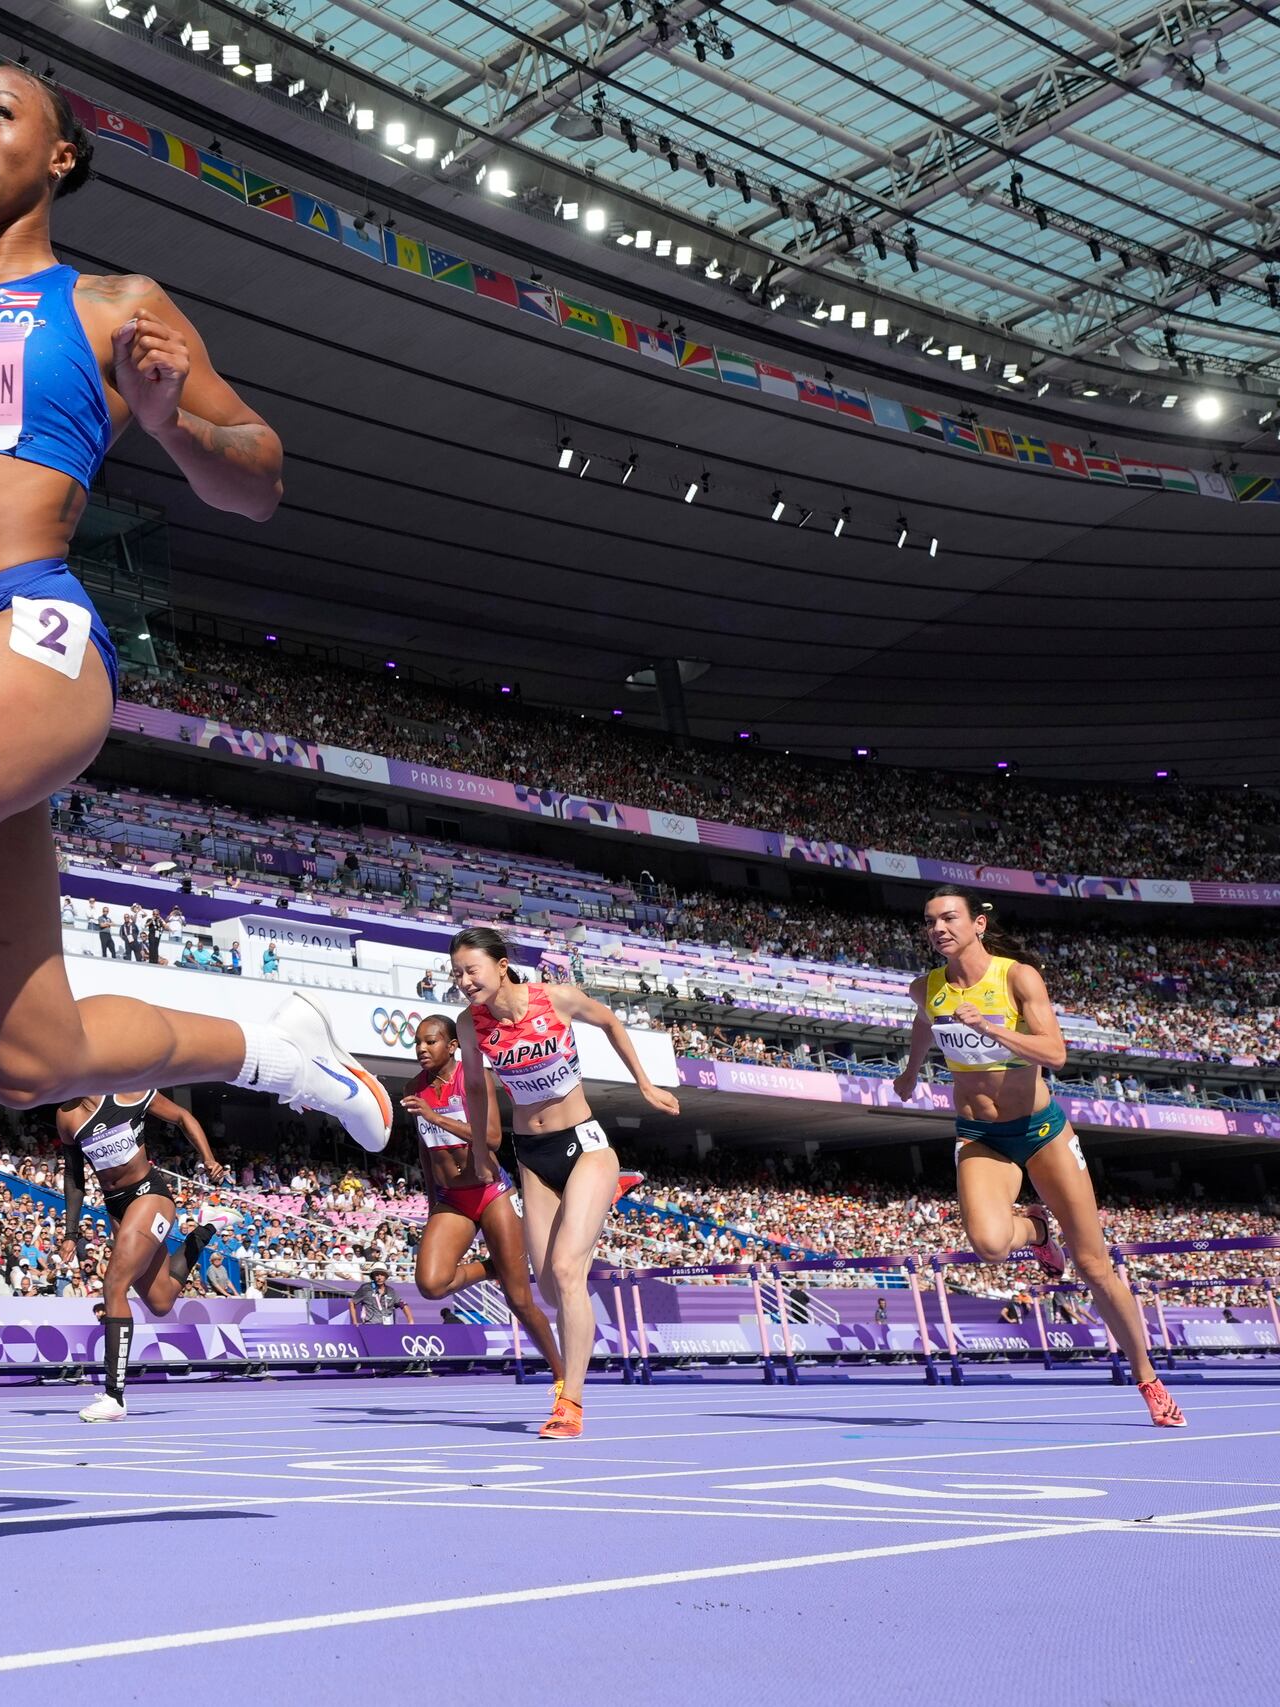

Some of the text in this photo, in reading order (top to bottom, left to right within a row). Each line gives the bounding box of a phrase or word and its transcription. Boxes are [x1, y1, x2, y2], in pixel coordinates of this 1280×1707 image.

[36, 608, 69, 656] 2
[411, 770, 495, 797] PARIS 2024
[941, 866, 1010, 884] PARIS 2024
[1219, 888, 1259, 900] PARIS
[247, 925, 343, 951] PARIS 2024
[493, 1037, 558, 1066] JAPAN
[506, 1066, 569, 1092] TANAKA
[699, 1070, 717, 1086] S13
[730, 1070, 805, 1090] PARIS 2024
[933, 1094, 950, 1108] S12
[586, 1127, 601, 1143] 4
[87, 1135, 135, 1160] MORRISON
[157, 1222, 165, 1235] 6
[672, 1267, 709, 1276] PARIS 2024
[257, 1341, 359, 1360] PARIS 2024
[671, 1340, 745, 1353] PARIS 2024
[972, 1336, 1030, 1350] PARIS 2024
[116, 1326, 129, 1389] LIBERI
